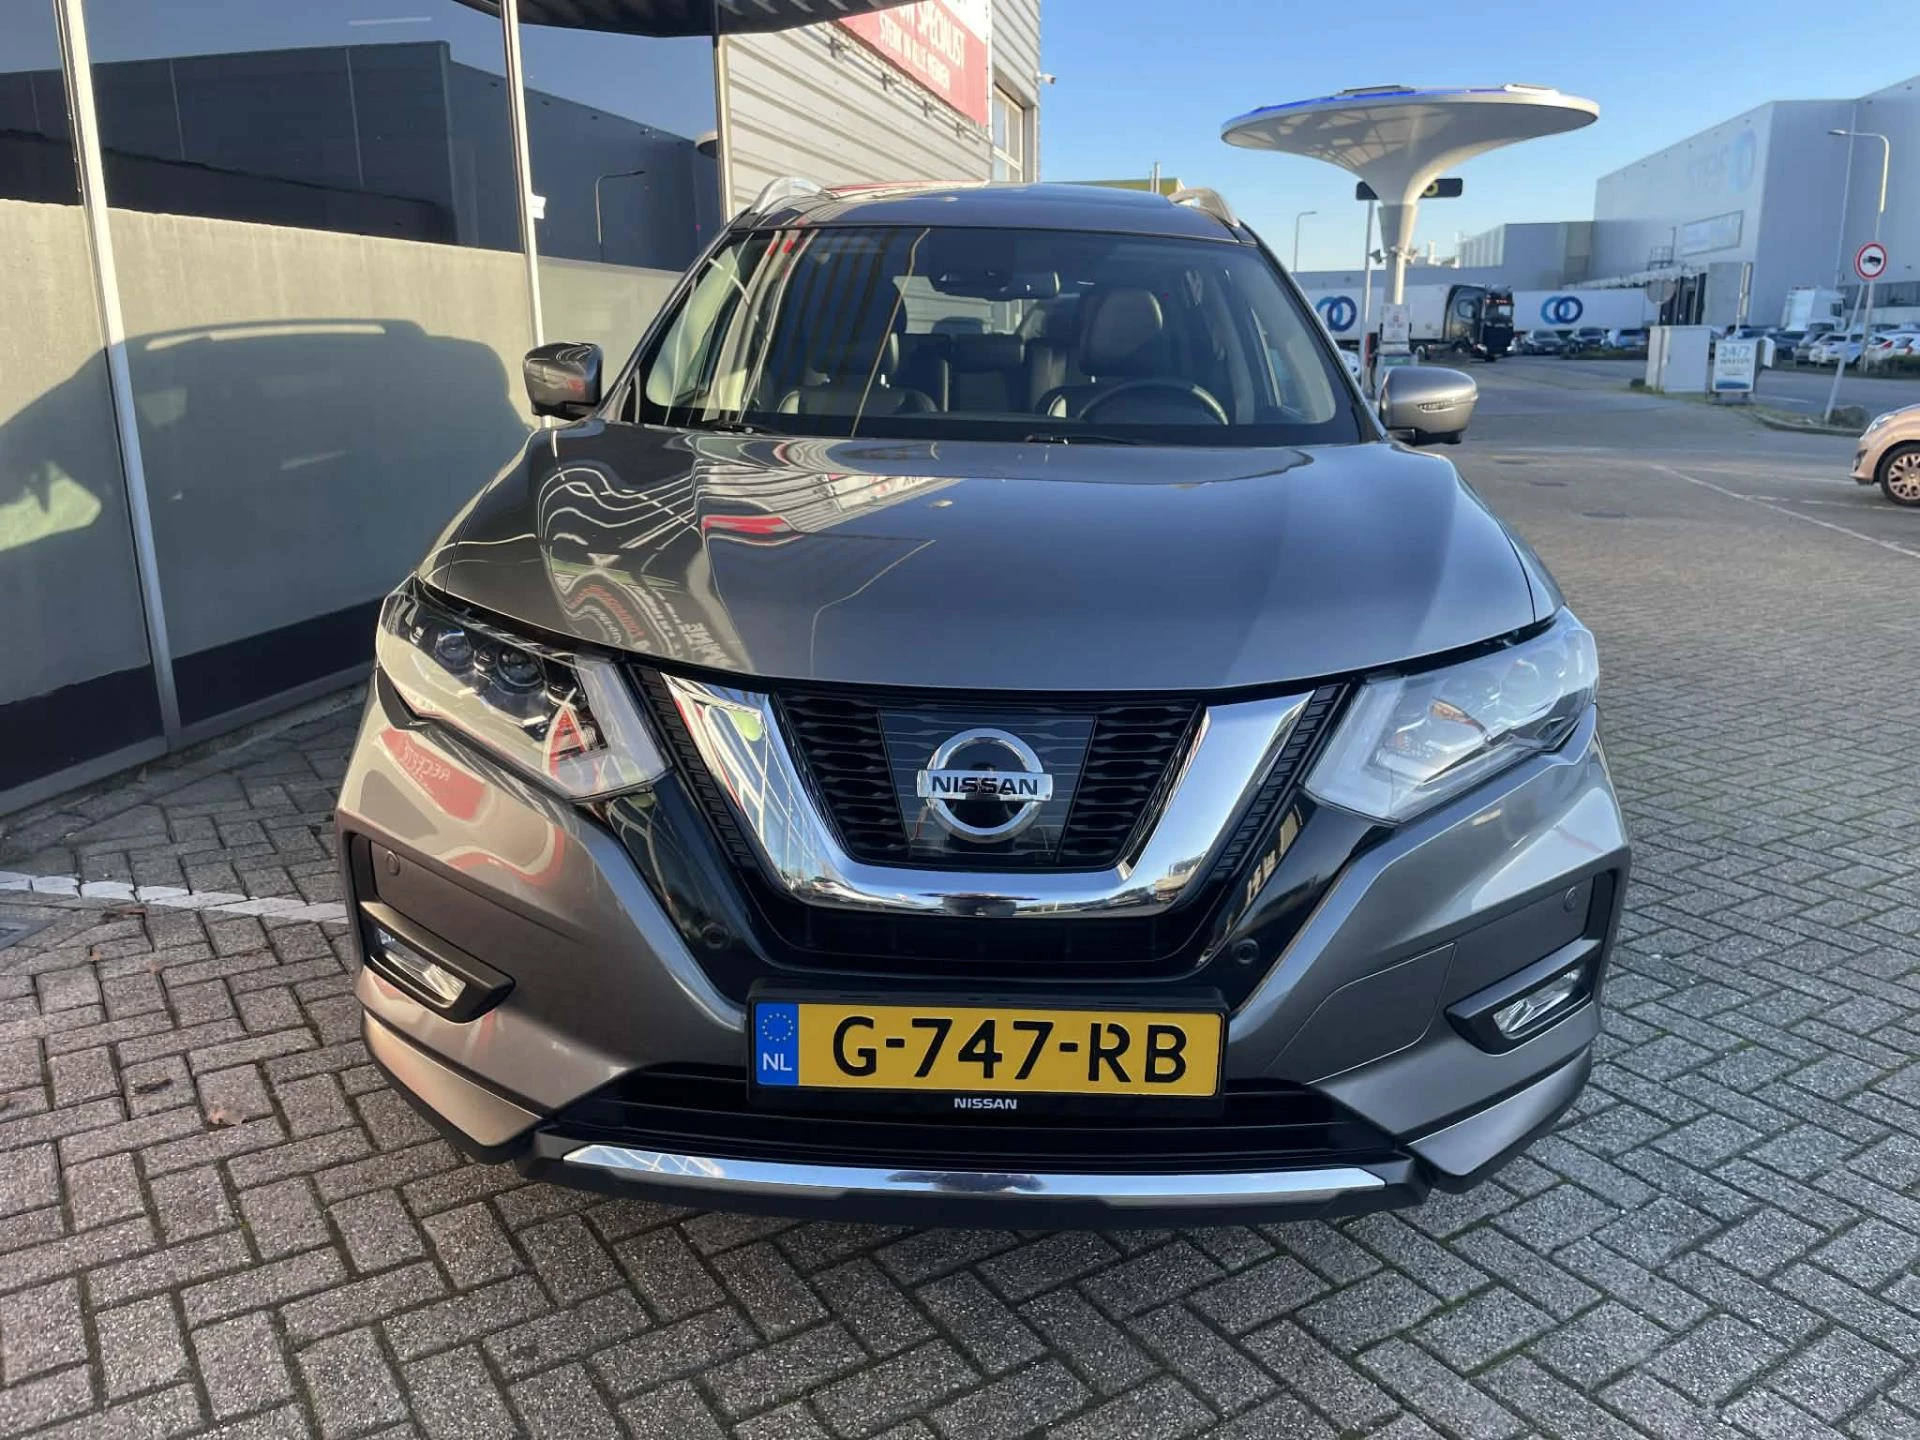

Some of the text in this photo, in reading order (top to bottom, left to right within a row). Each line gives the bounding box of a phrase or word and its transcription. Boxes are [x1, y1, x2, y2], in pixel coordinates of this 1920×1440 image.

[932, 776, 1037, 796] NISSAN
[833, 1016, 1187, 1083] G-747-RB
[763, 1053, 793, 1071] NL
[954, 1098, 1018, 1110] NISSAN
